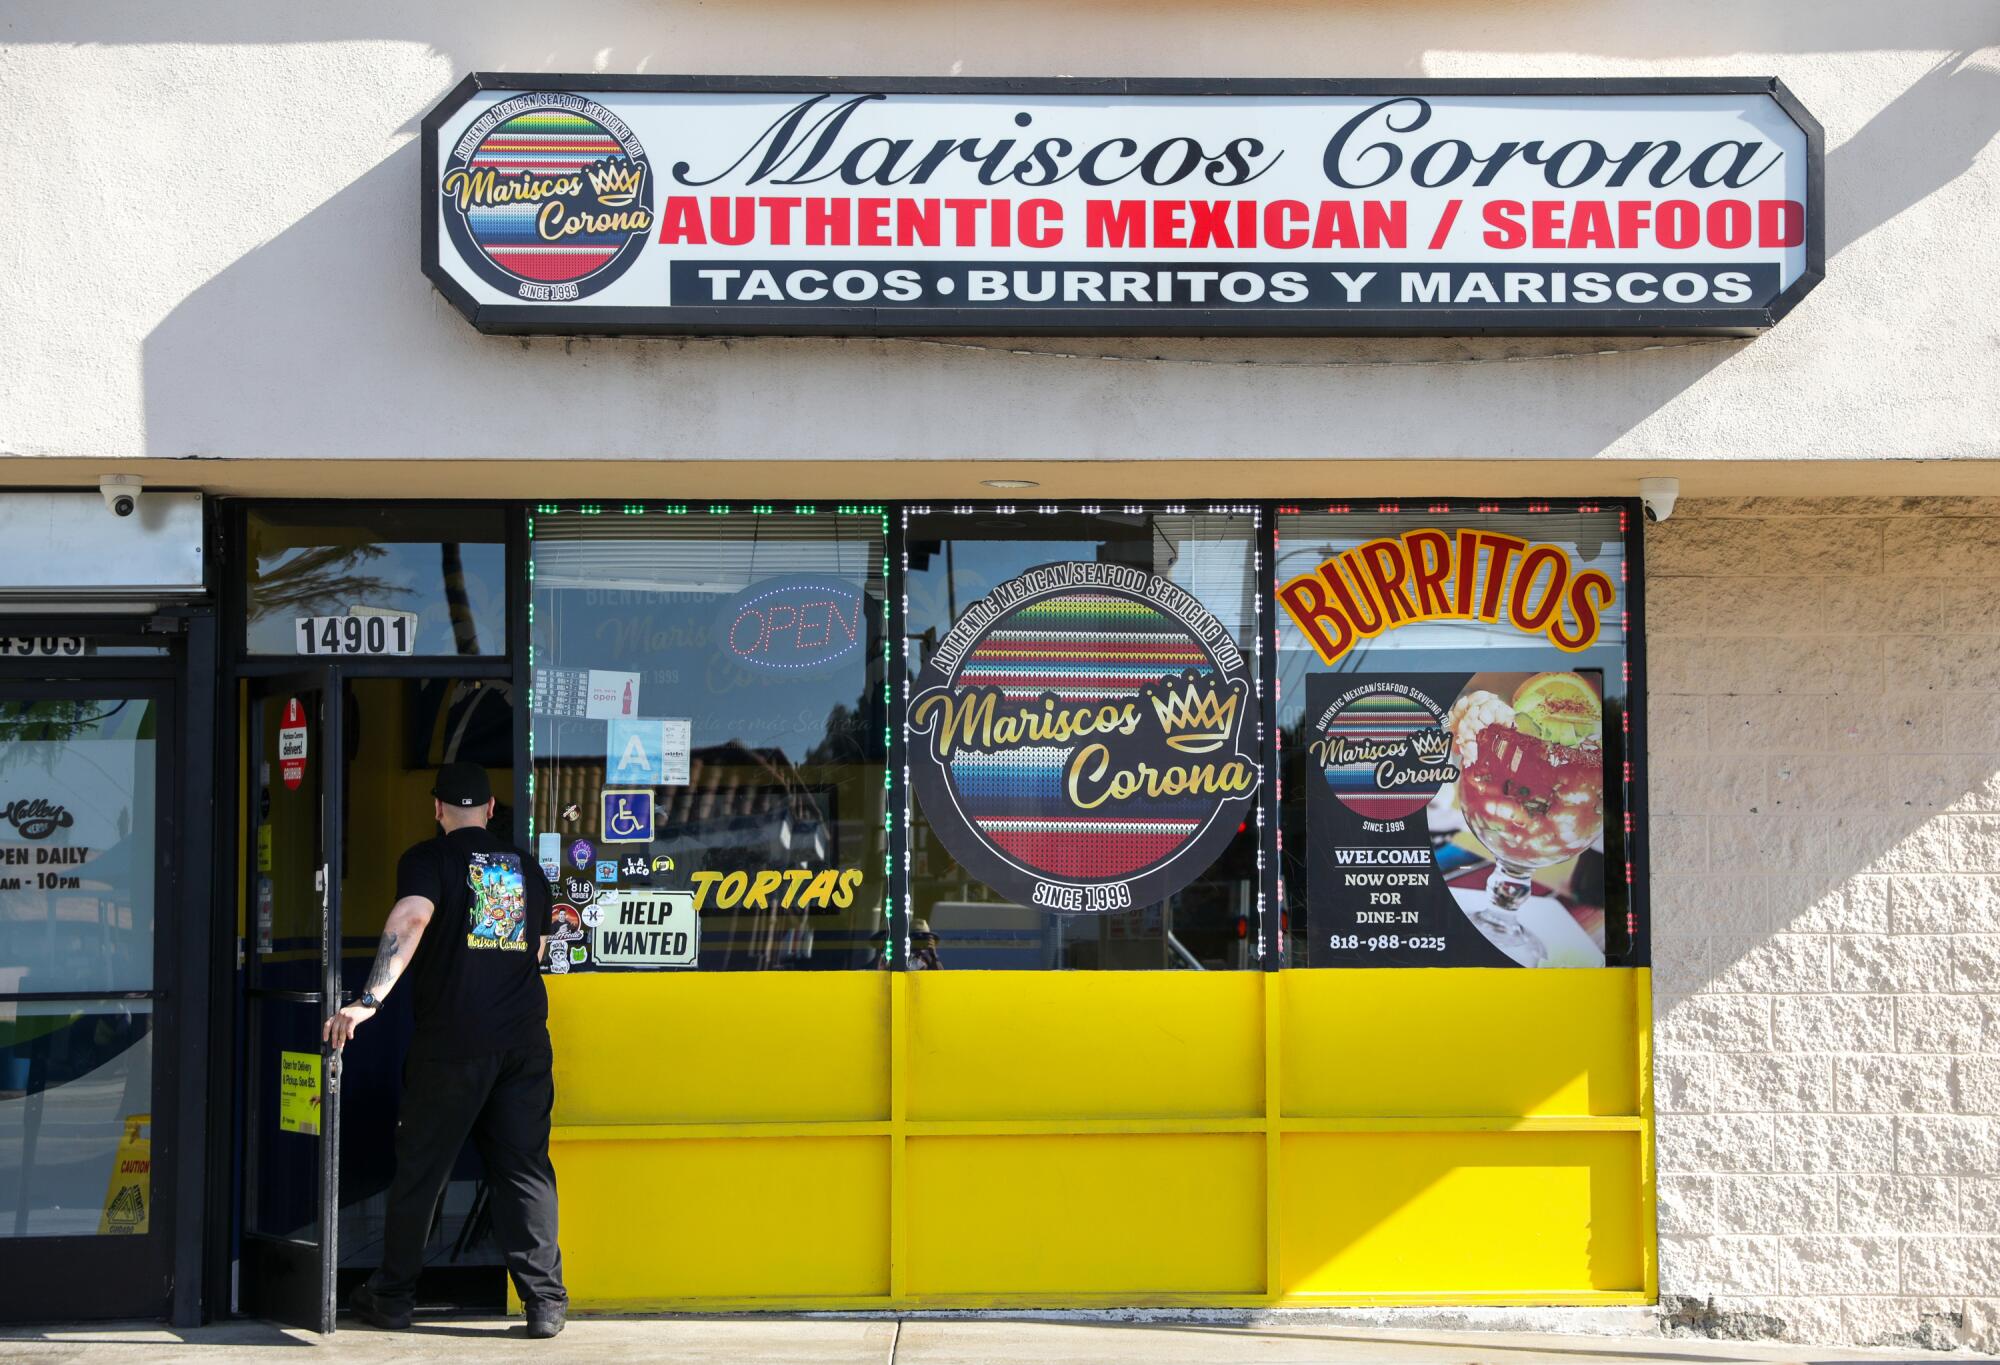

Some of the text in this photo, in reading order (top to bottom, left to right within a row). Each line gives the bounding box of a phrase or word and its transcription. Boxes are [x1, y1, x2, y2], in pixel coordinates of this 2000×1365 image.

[454, 92, 645, 161] AUTHENTIC MEXICAN/SEAFOOD SERVICING YOU
[672, 93, 1784, 189] Mariscos Corona
[446, 171, 583, 210] Mariscos
[539, 201, 651, 240] Corona
[658, 196, 1064, 249] AUTHENTIC
[1085, 198, 1408, 250] MEXICAN
[1482, 199, 1805, 250] SEAFOOD
[518, 284, 579, 300] SINCE 1999
[698, 268, 1754, 304] TACOS BURRITOS Y MARISCOS
[1276, 528, 1617, 667] BURRITOS
[728, 598, 861, 656] OPEN
[930, 562, 1243, 676] AUTHENTIC MEXICAN/SEAFOOD SERVICING YOU
[301, 616, 406, 653] 14901
[593, 694, 617, 703] open
[1315, 682, 1451, 732] AUTHENTIC MEXICAN/SEAFOOD SERVICING YOU
[915, 692, 1142, 757] Mariscos
[617, 734, 652, 771] A
[1309, 739, 1408, 767] Mariscos
[1068, 743, 1253, 809] Corona
[1376, 760, 1457, 789] Corona
[1362, 820, 1405, 833] SINCE 1999
[36, 847, 89, 864] DAILY
[627, 857, 647, 868] L.A.
[1334, 850, 1431, 864] WELCOME
[37, 872, 80, 889] 10PM
[622, 866, 650, 877] TACO
[1344, 874, 1430, 886] NOW OPEN
[571, 882, 590, 893] 818
[690, 868, 864, 911] TORTAS
[1033, 883, 1131, 911] SINCE 1999
[1370, 892, 1402, 905] FOR
[619, 901, 673, 925] HELP
[1356, 911, 1419, 924] DINE-IN
[603, 931, 688, 956] WANTED
[1330, 934, 1446, 951] 818-988-0225
[121, 1160, 150, 1173] CAUTION
